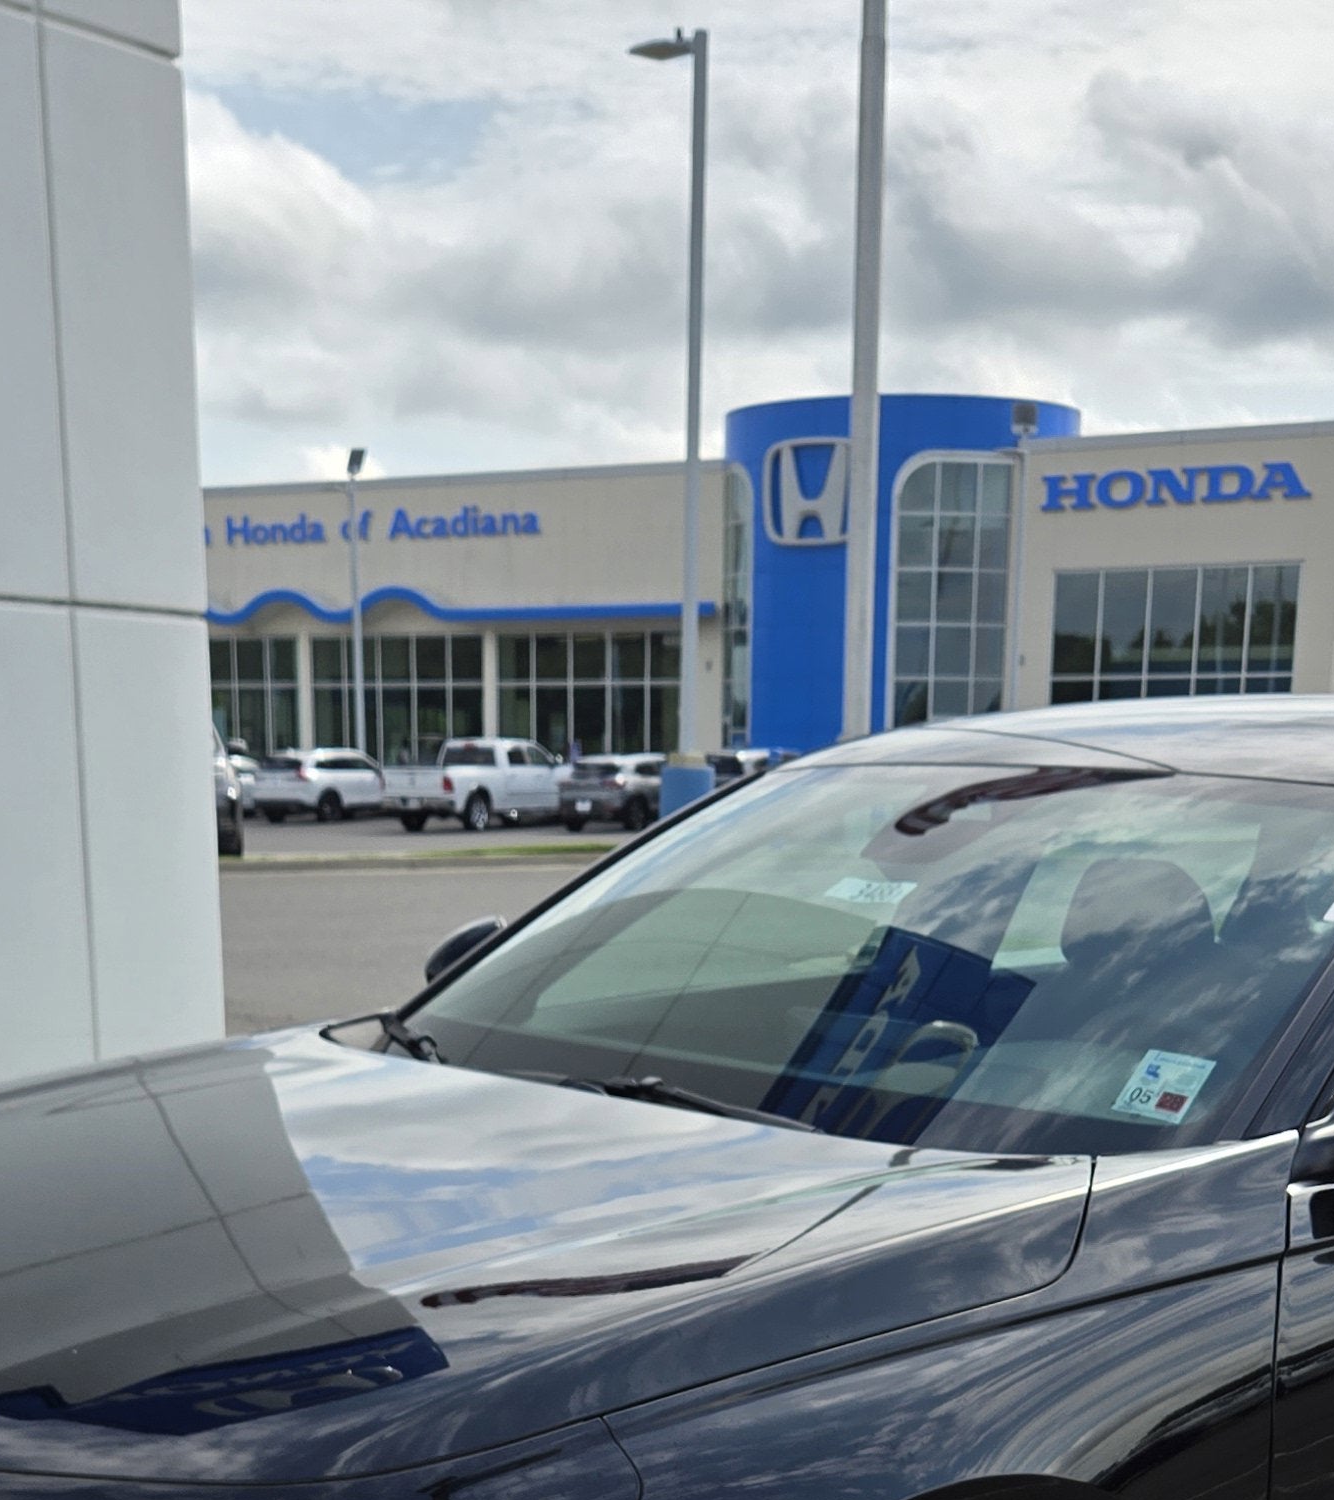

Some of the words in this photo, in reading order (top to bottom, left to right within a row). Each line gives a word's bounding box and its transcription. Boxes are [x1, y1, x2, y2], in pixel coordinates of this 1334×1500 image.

[1040, 461, 1312, 512] HONDA
[226, 512, 326, 545] Honda
[341, 509, 371, 541] of
[389, 505, 539, 541] Acadiana
[1129, 1086, 1154, 1104] 05
